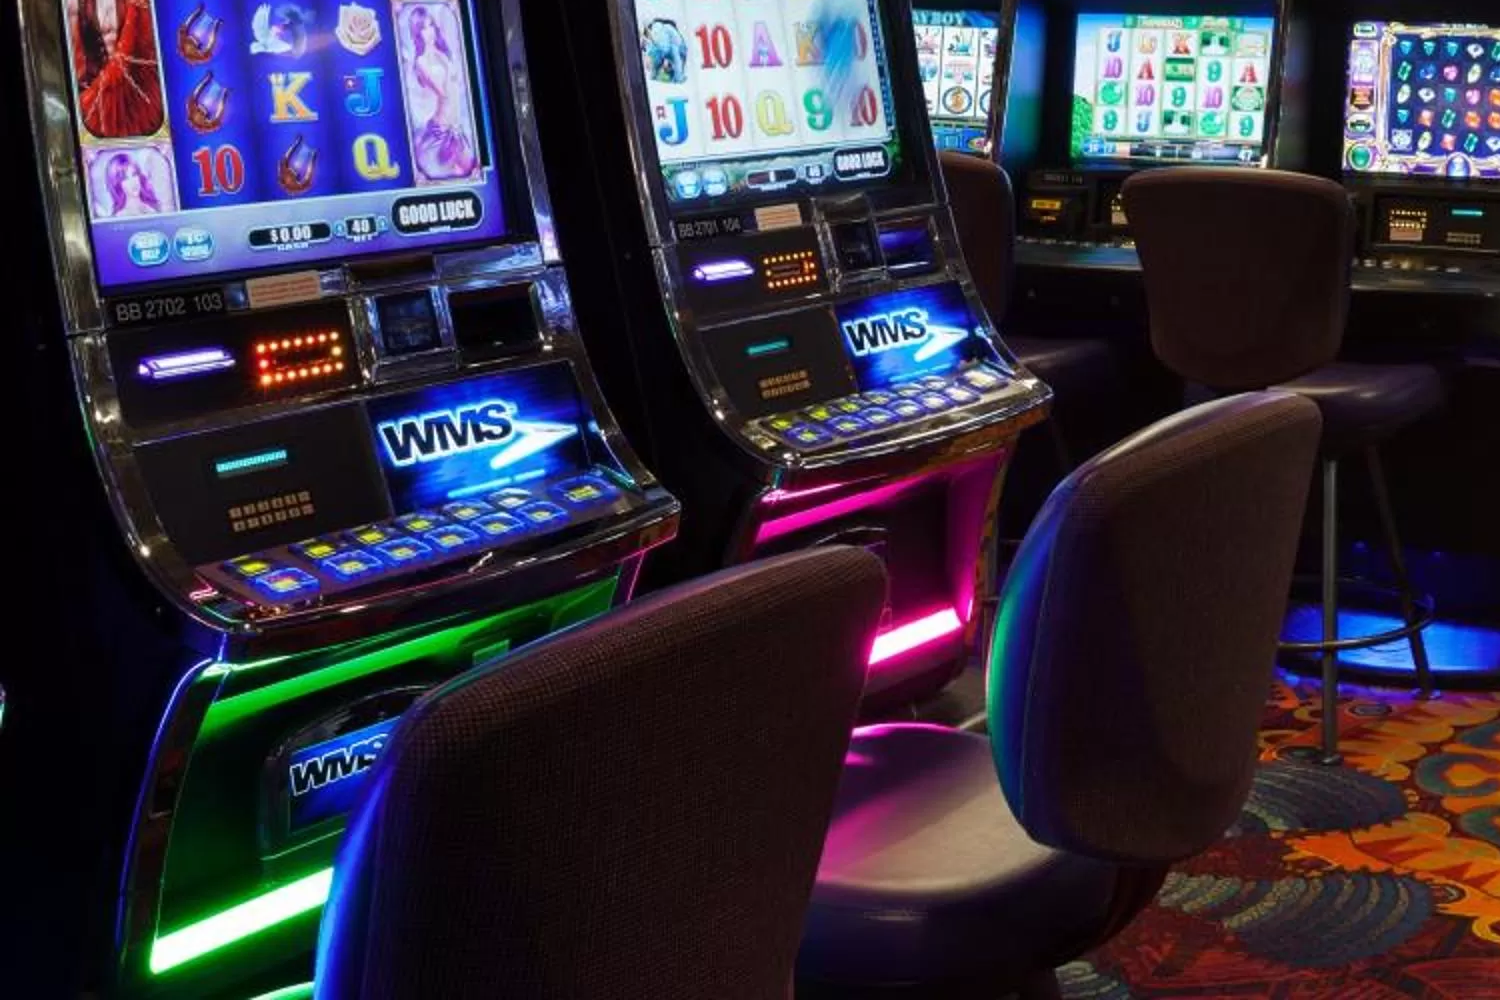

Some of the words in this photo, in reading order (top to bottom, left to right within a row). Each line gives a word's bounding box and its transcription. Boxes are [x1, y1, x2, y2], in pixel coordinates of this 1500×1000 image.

[695, 23, 734, 69] 10
[749, 20, 784, 68] A
[269, 71, 318, 123] K
[346, 67, 385, 118] J
[656, 96, 690, 146] J
[706, 95, 743, 140] 10
[756, 88, 794, 137] Q
[803, 87, 833, 131] 9
[192, 144, 244, 196] 10
[352, 133, 399, 182] Q
[270, 224, 313, 243] $0.00
[351, 220, 370, 234] 40
[399, 203, 439, 226] GOOD
[440, 198, 475, 223] LUCK
[116, 302, 143, 322] BB
[145, 297, 185, 319] 2702
[194, 292, 223, 313] 103
[845, 309, 928, 356] WMS
[380, 400, 516, 466] WMS
